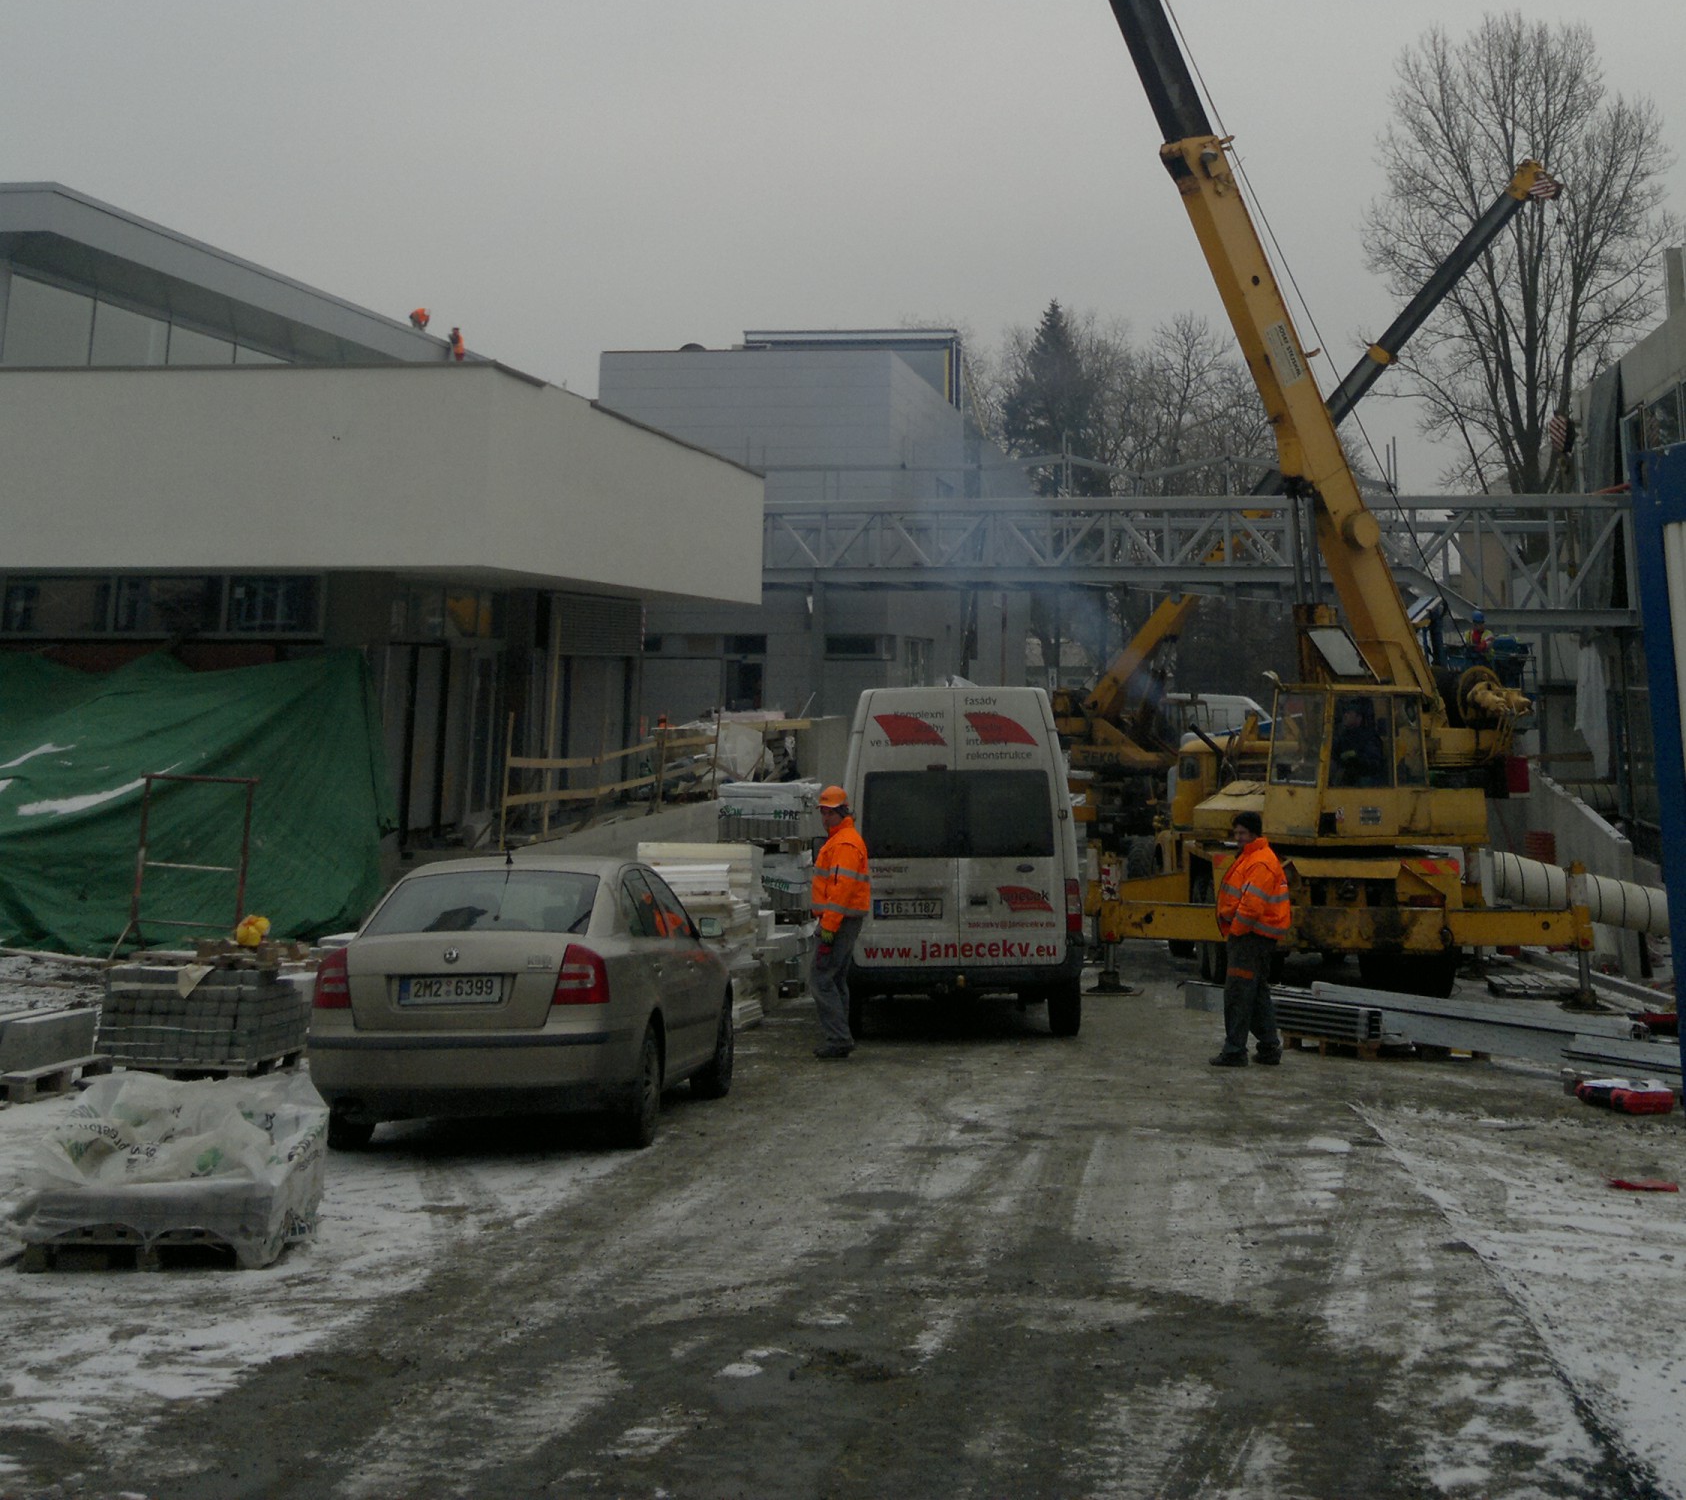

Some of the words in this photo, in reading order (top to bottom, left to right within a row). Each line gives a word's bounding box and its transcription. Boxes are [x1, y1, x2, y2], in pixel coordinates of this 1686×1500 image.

[966, 751, 1033, 761] rekonstrukce
[864, 939, 1057, 961] www.janecekv.eu
[414, 980, 443, 998] 2M2
[455, 979, 494, 996] 6399
